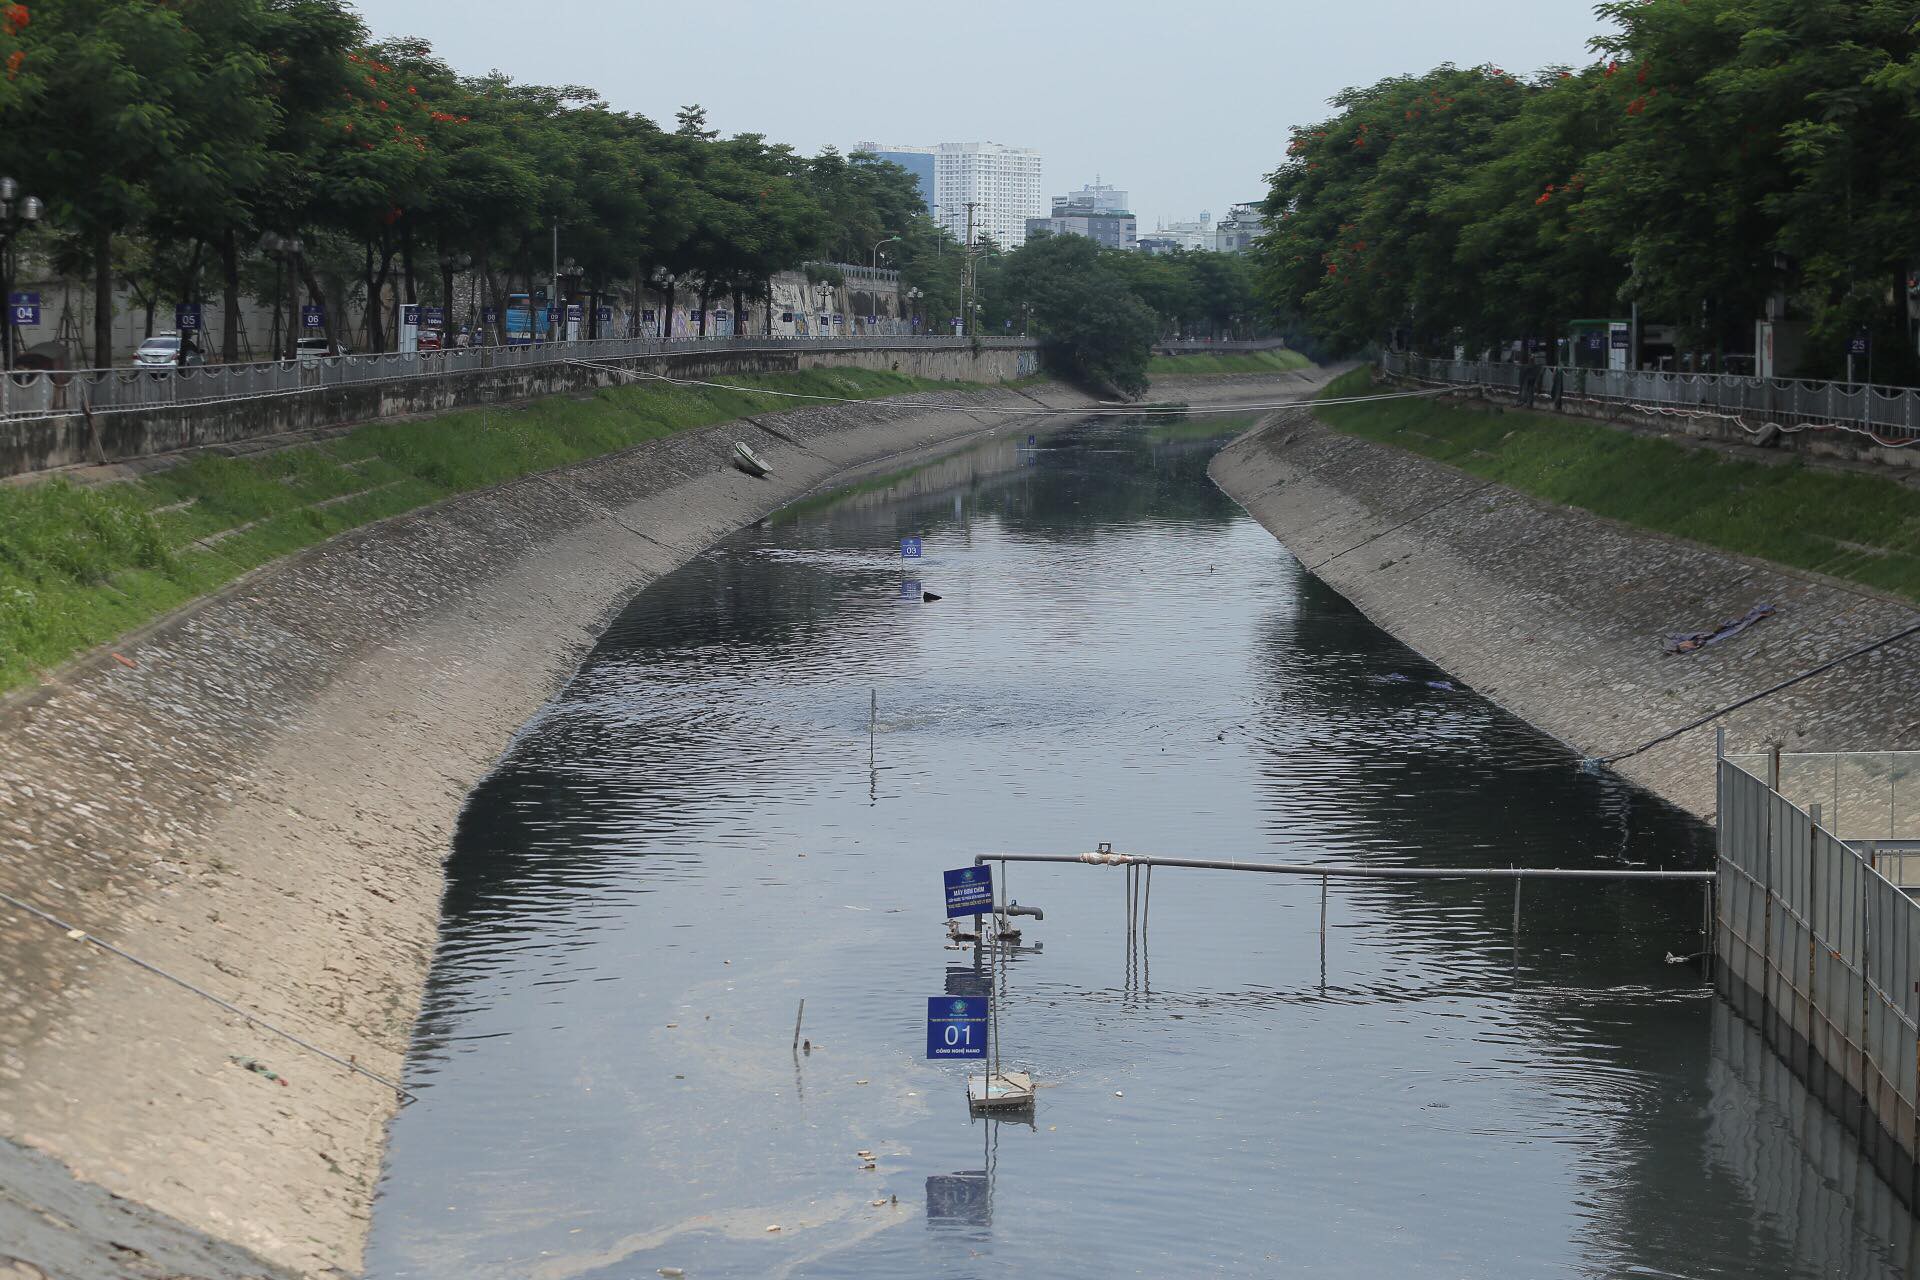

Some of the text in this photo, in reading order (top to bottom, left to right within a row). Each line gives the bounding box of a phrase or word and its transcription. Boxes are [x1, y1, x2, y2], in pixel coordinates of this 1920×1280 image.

[17, 307, 33, 319] 04
[182, 315, 195, 325] 05
[307, 315, 319, 323] 06
[408, 314, 417, 322] 07
[1851, 339, 1865, 350] 25
[906, 546, 917, 555] 03
[944, 1025, 970, 1046] 01
[951, 1047, 965, 1055] NGHỆ
